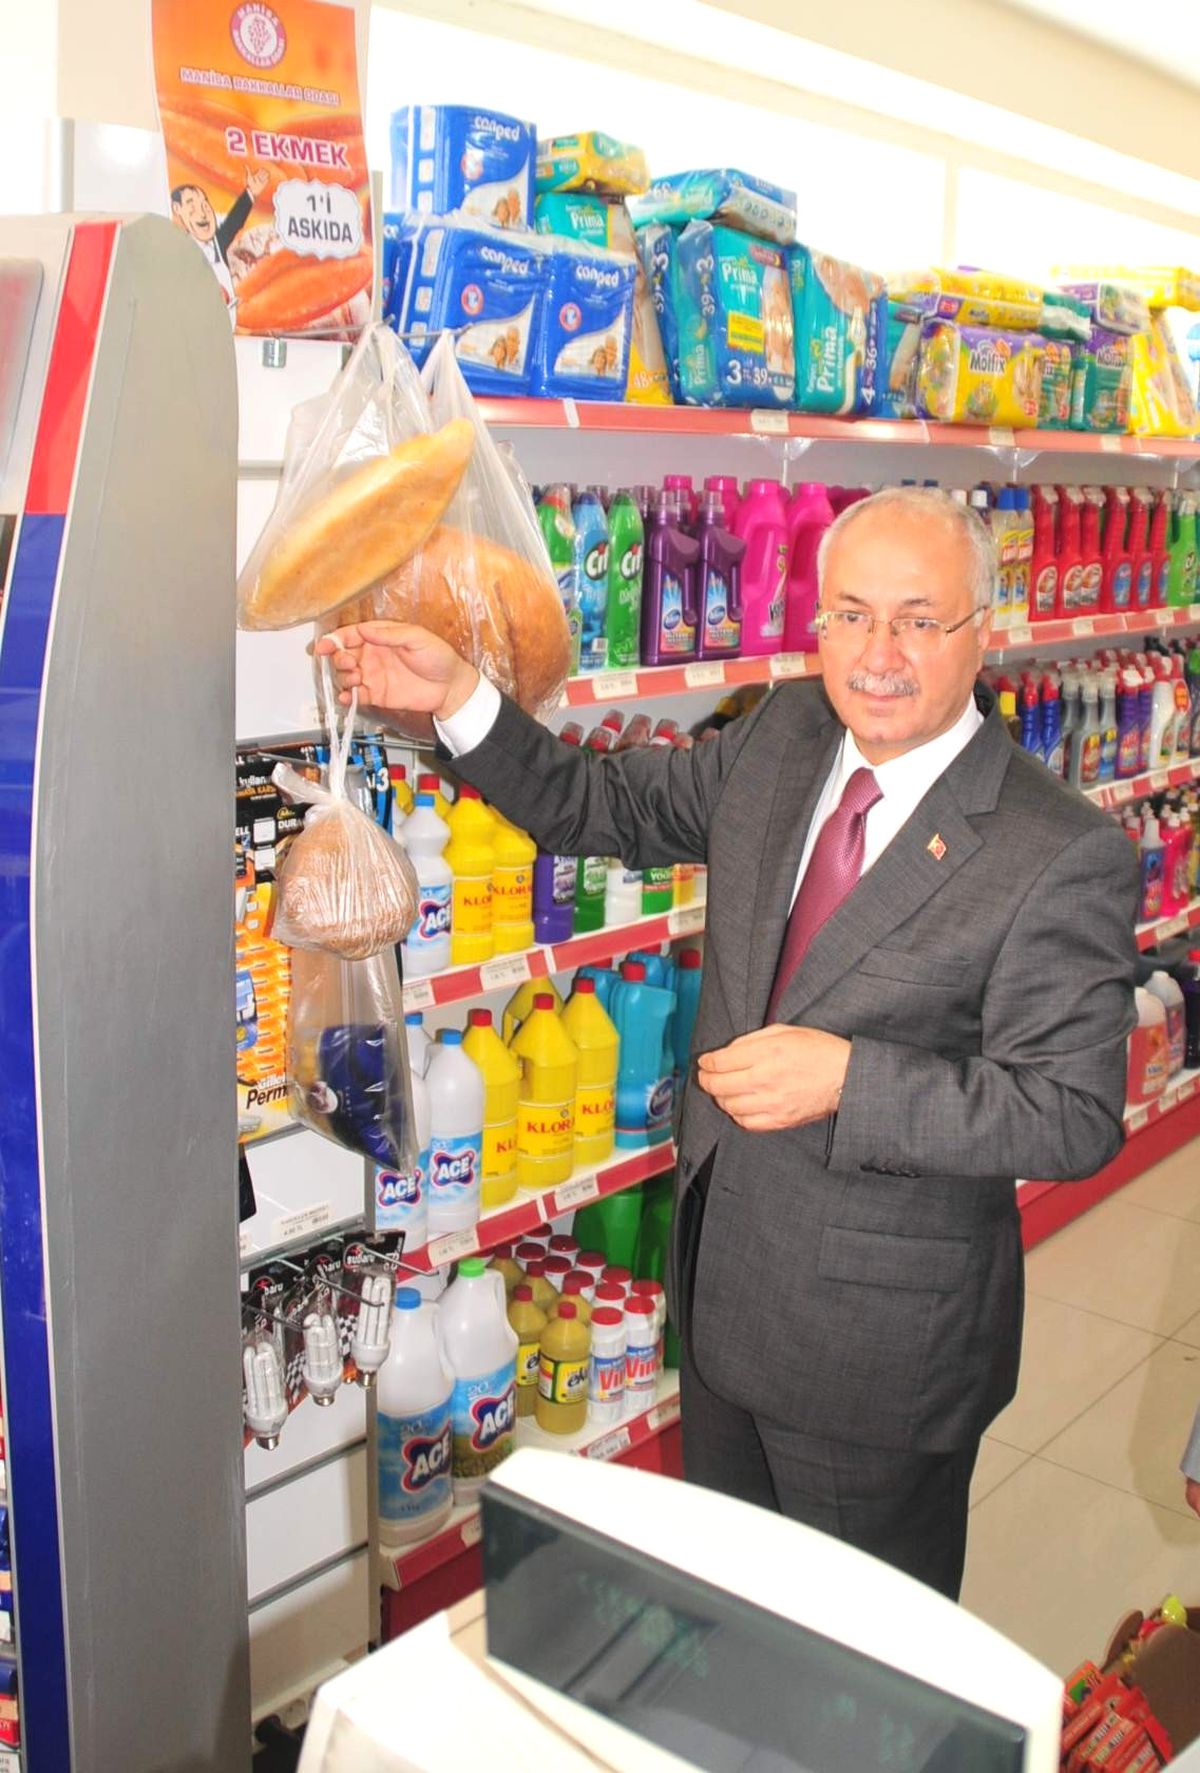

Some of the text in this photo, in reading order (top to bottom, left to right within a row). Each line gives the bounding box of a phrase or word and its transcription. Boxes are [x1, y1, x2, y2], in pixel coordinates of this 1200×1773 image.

[180, 67, 232, 89] MANİSA
[474, 115, 520, 141] canped
[225, 127, 349, 167] 2 EKMEK
[288, 217, 353, 243] ASKIDA
[480, 246, 529, 275] canped
[576, 264, 620, 287] canped
[722, 263, 758, 284] Prima
[817, 326, 838, 392] Prima
[970, 350, 1005, 374] Molfix
[438, 1156, 470, 1179] ACE
[384, 1175, 417, 1200] ACE
